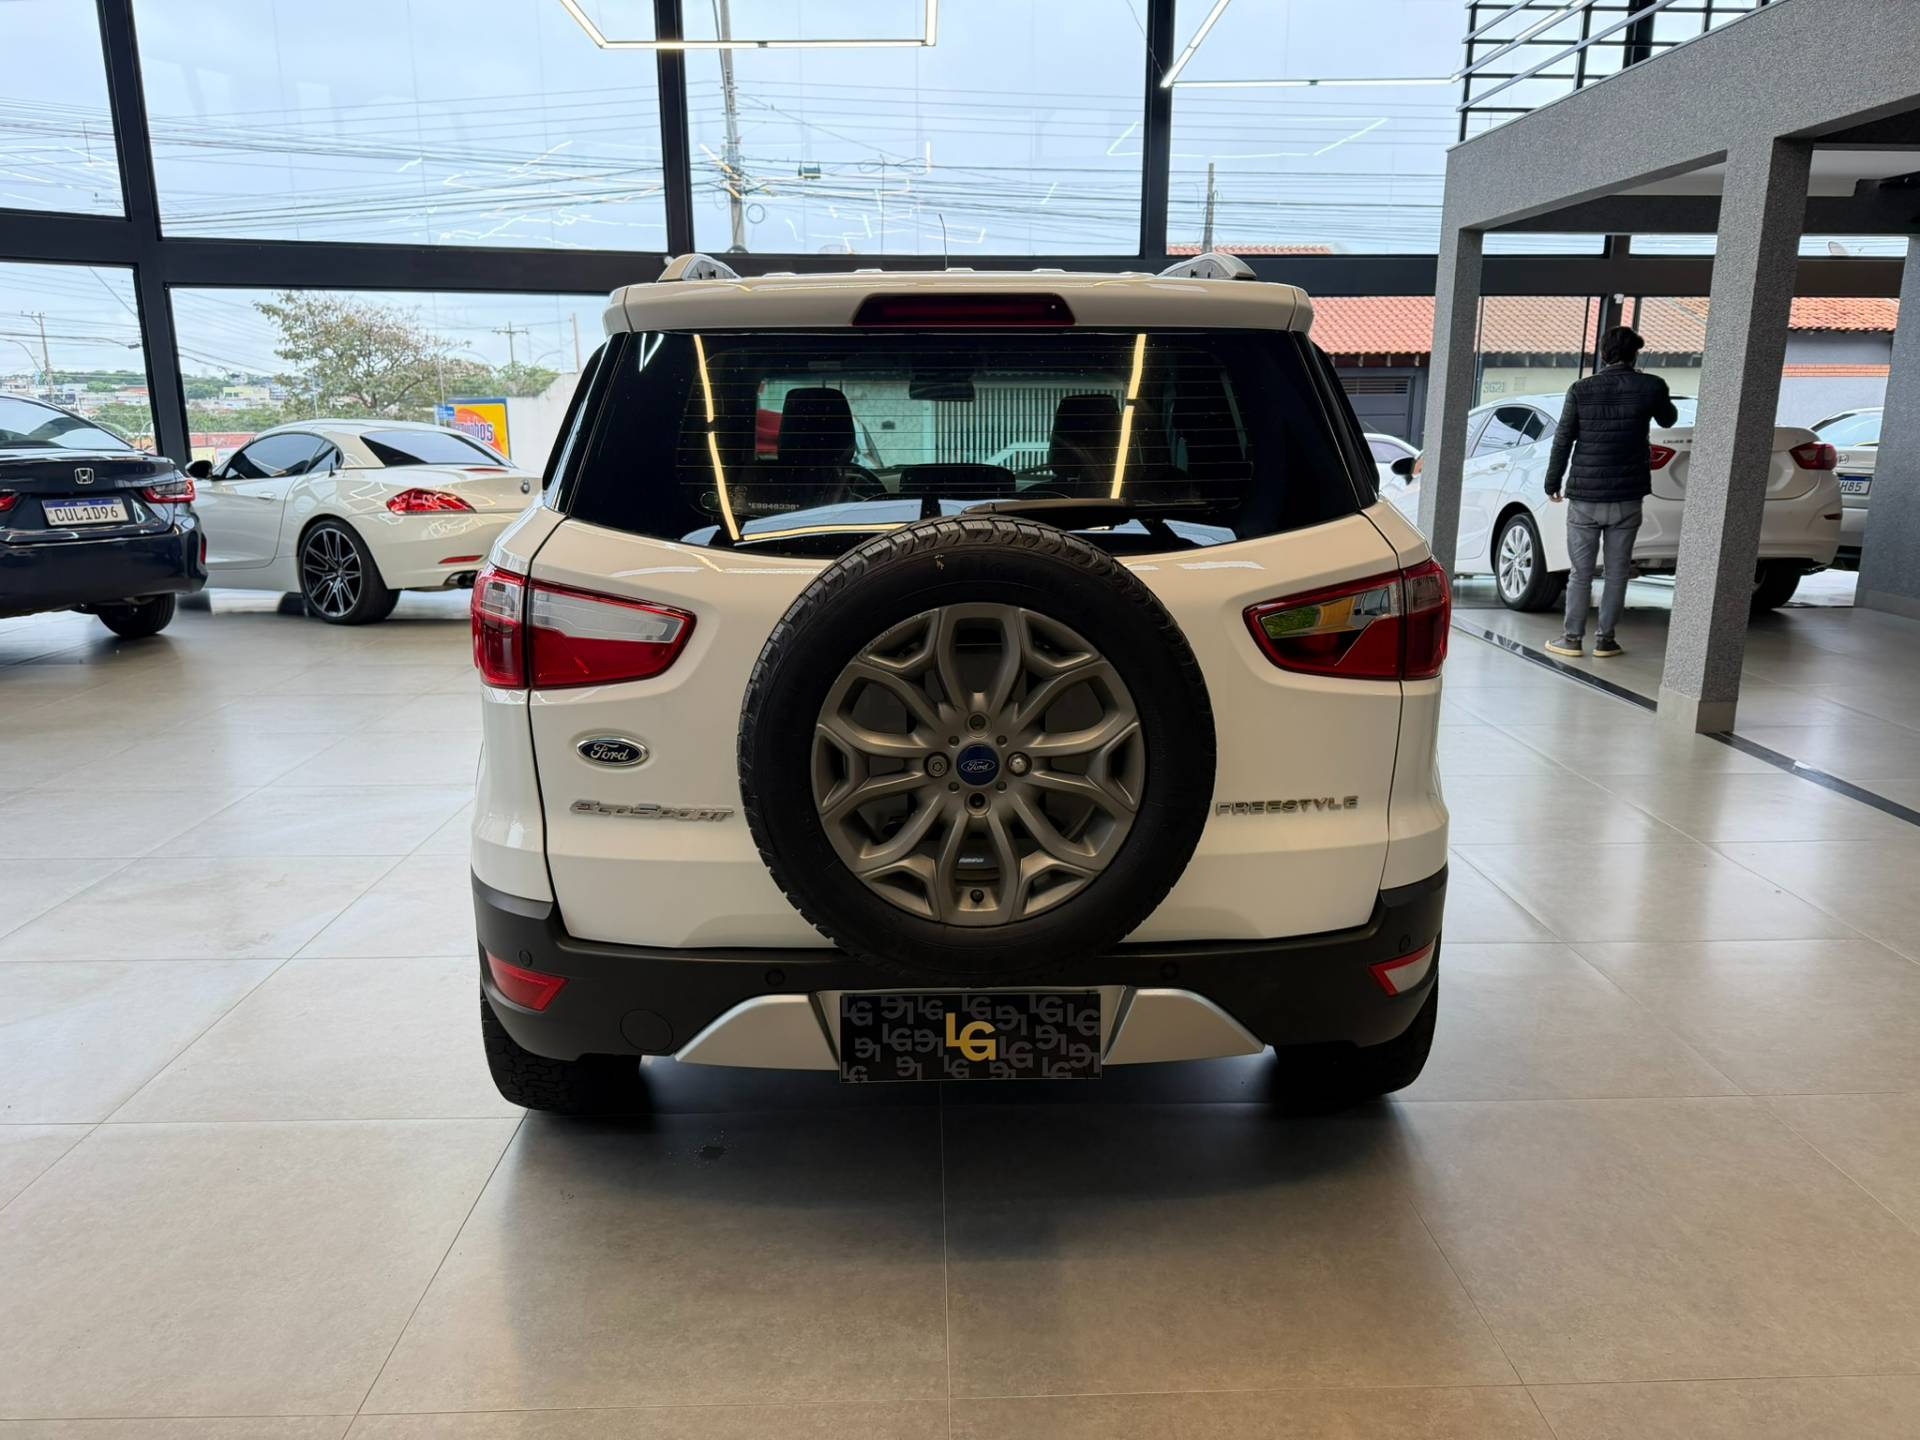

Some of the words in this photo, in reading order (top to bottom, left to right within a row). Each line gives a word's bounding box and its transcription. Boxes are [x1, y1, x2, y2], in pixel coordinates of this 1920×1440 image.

[54, 506, 118, 522] CUL1D96
[590, 743, 629, 761] Ford
[966, 759, 989, 773] Ford
[1215, 796, 1359, 816] FREESTYLE
[946, 1012, 996, 1061] LG
